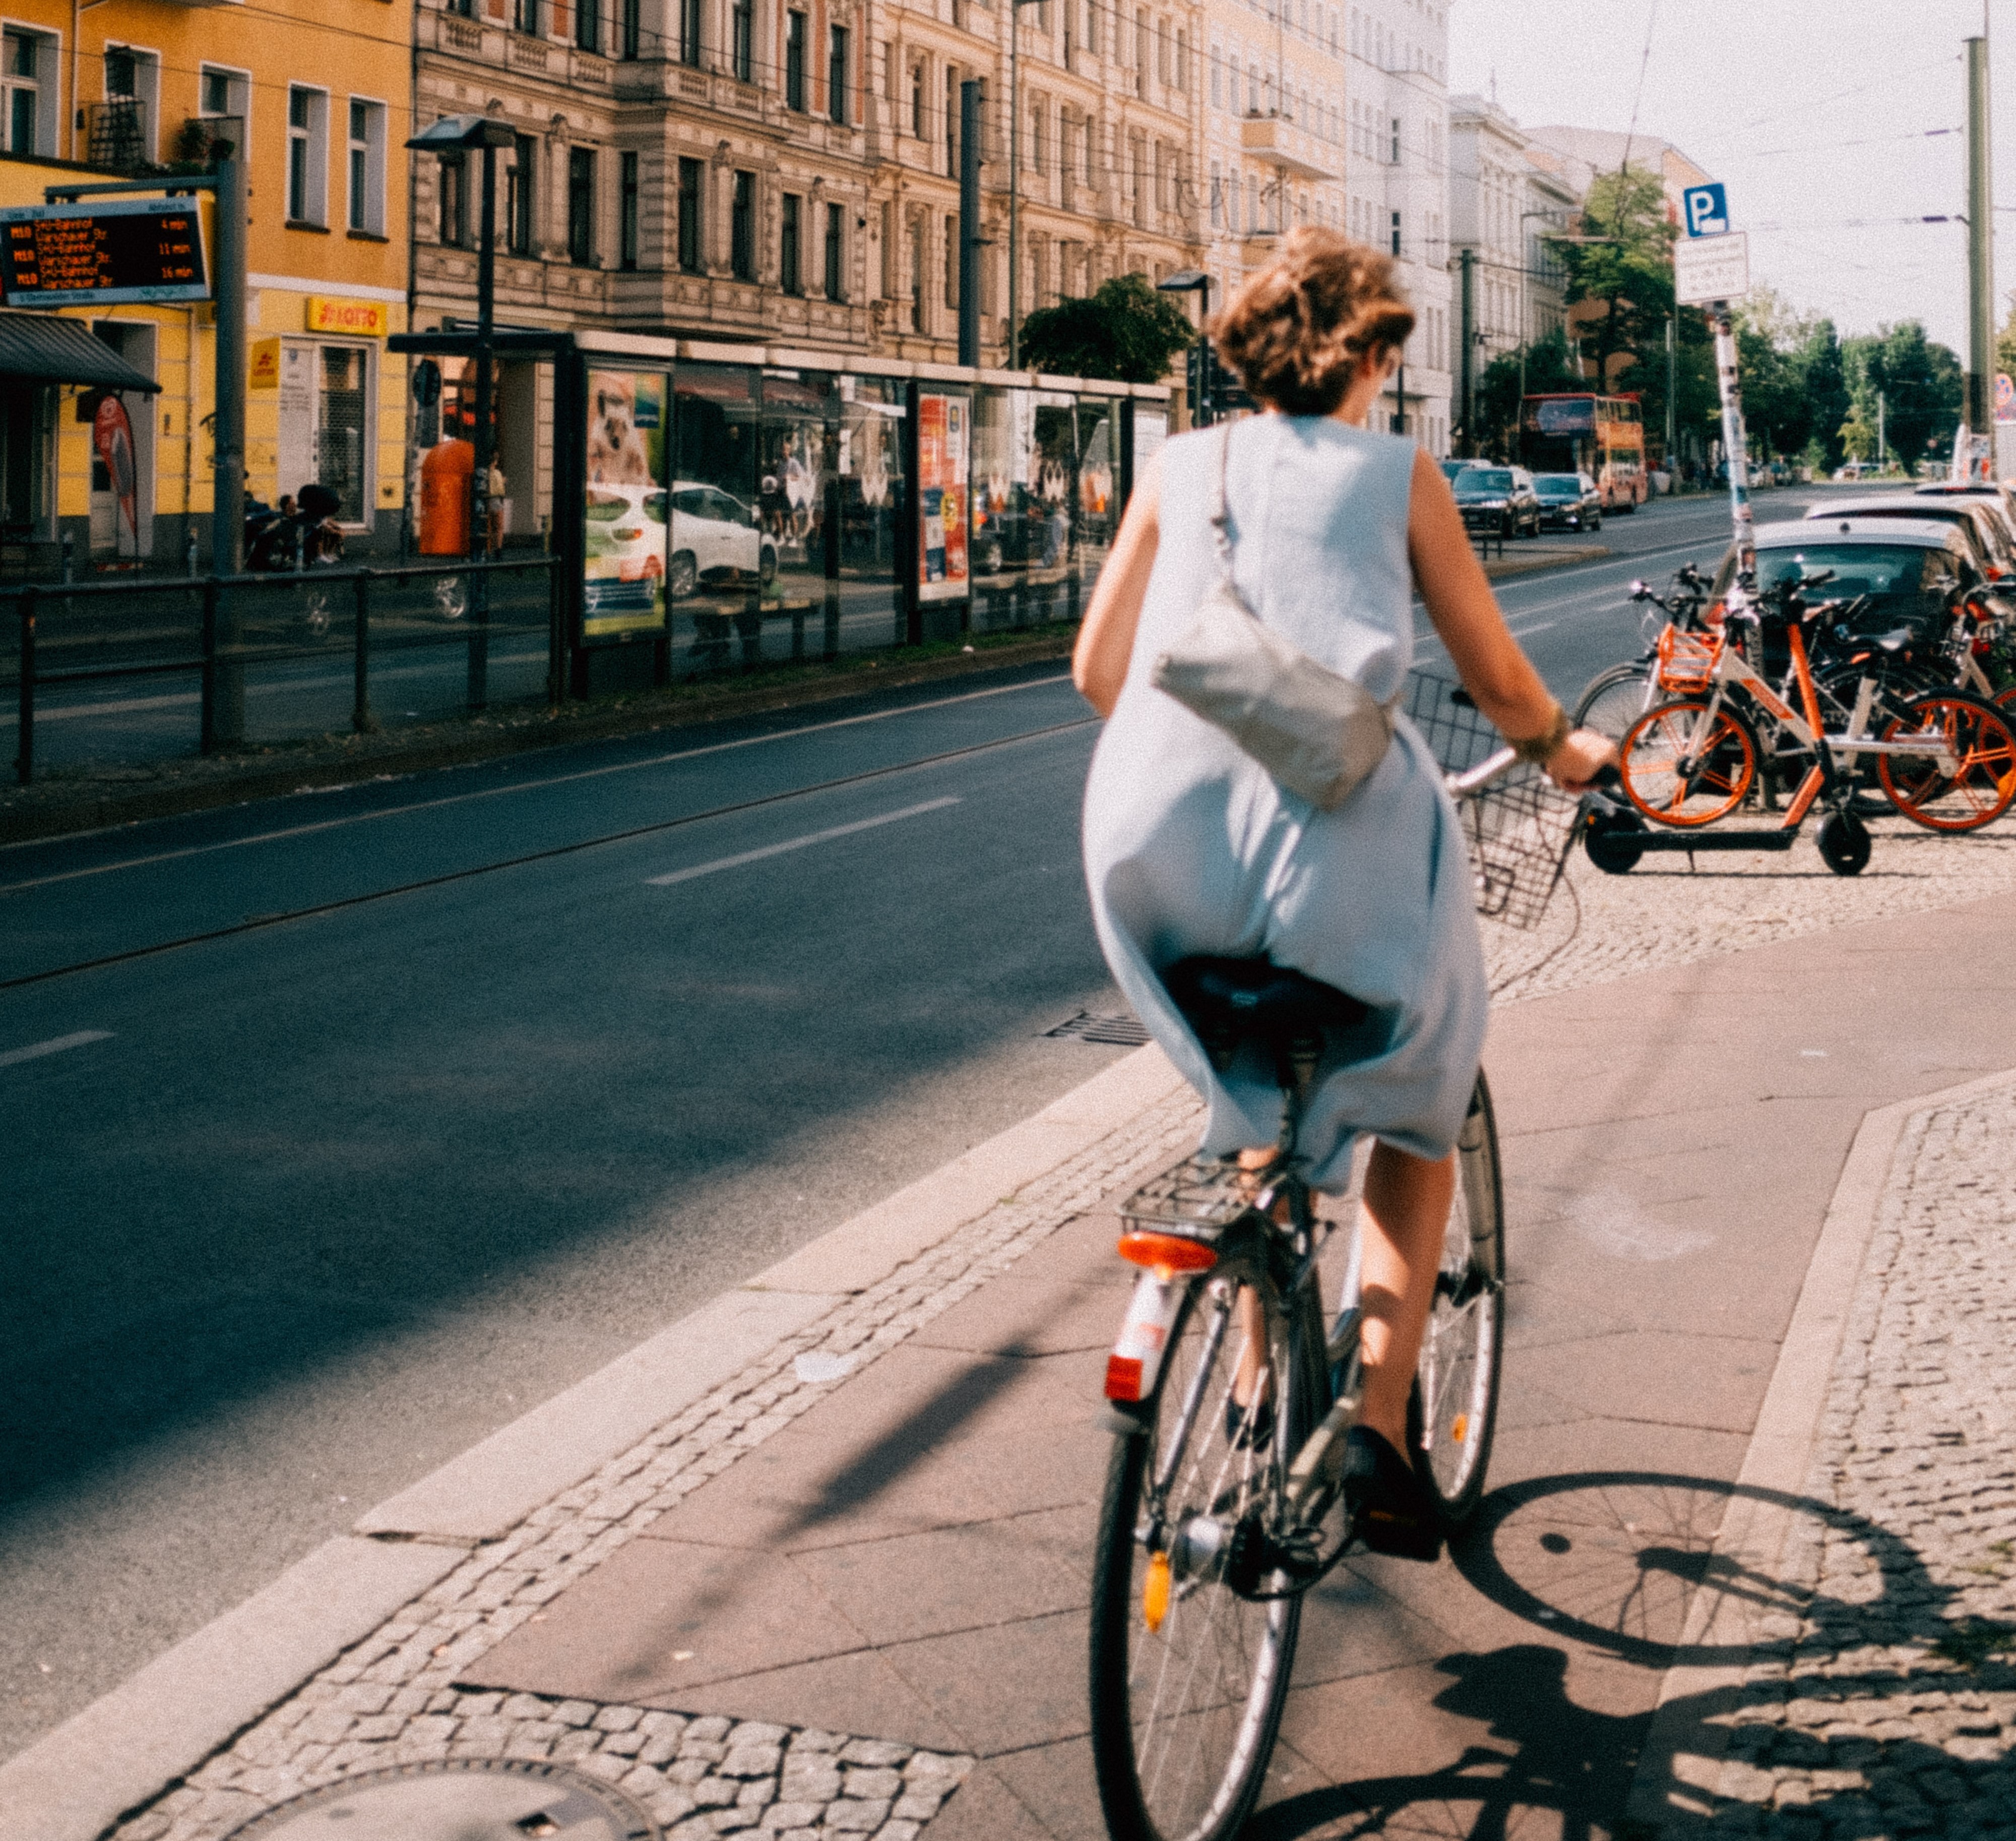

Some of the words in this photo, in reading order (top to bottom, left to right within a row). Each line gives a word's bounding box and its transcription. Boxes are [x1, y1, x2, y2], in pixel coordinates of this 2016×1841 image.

[1690, 191, 1714, 231] P
[161, 219, 168, 230] 4
[169, 219, 188, 231] min
[11, 226, 32, 239] M10
[158, 243, 170, 255] 11
[171, 242, 191, 254] min
[14, 250, 35, 262] M10
[16, 273, 38, 284] M10
[174, 267, 194, 278] min
[337, 306, 378, 327] LOTTO
